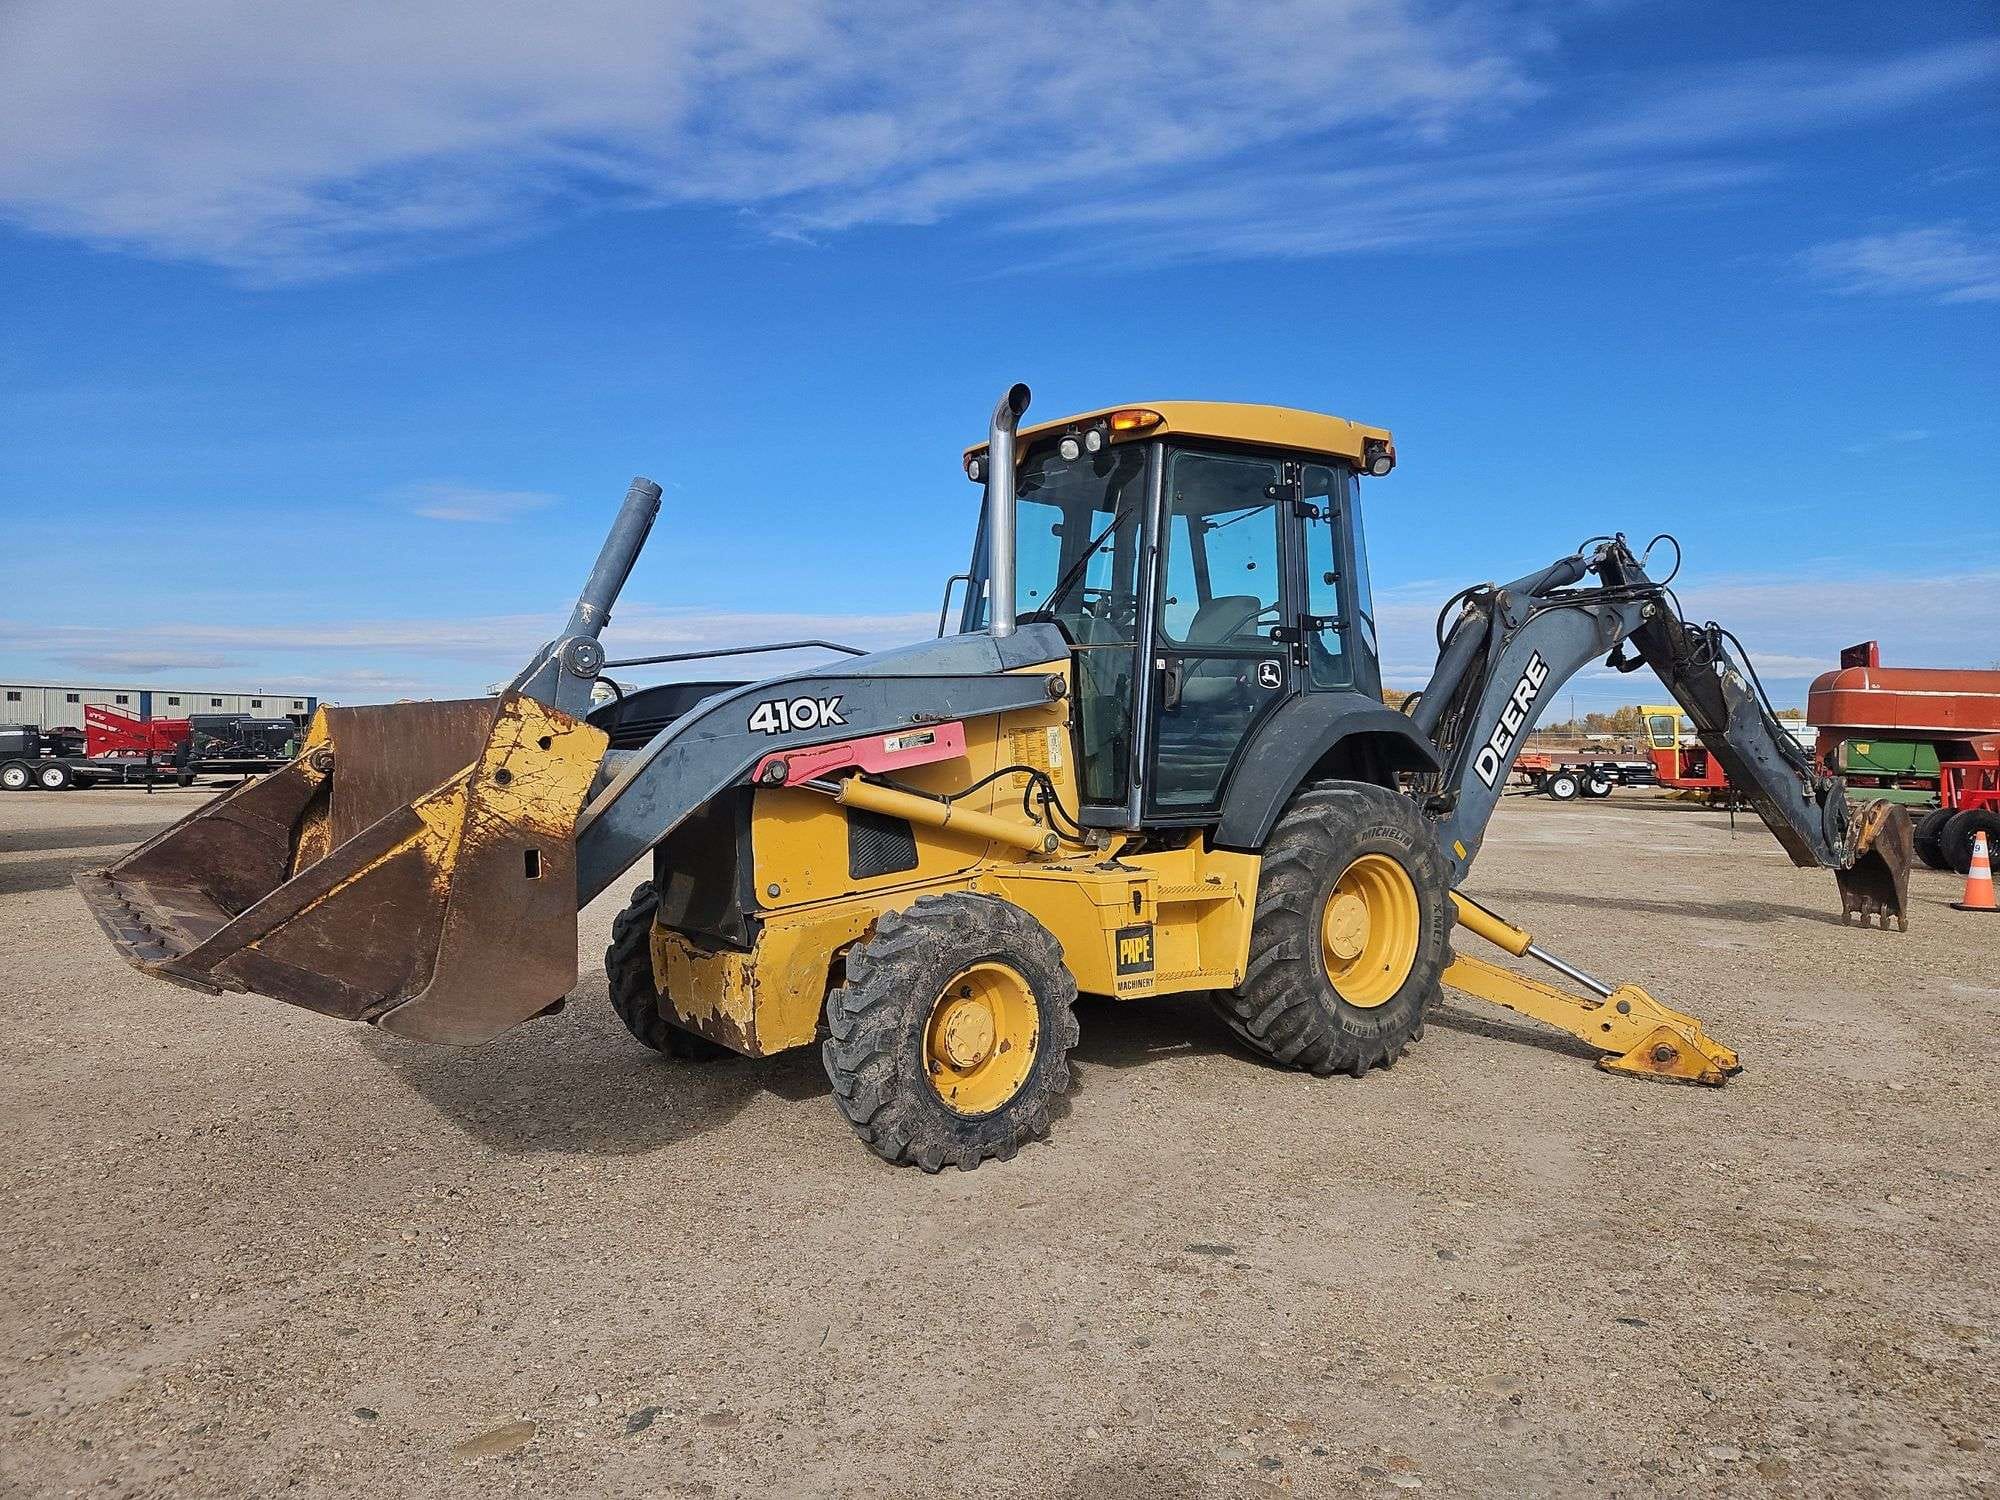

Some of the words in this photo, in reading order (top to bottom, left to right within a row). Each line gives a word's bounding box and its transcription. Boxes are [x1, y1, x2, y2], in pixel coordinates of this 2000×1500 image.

[748, 696, 848, 735] 410K
[1473, 650, 1549, 790] DEERE
[1361, 827, 1413, 848] MICHELIN
[1117, 977, 1154, 991] MACHINERY
